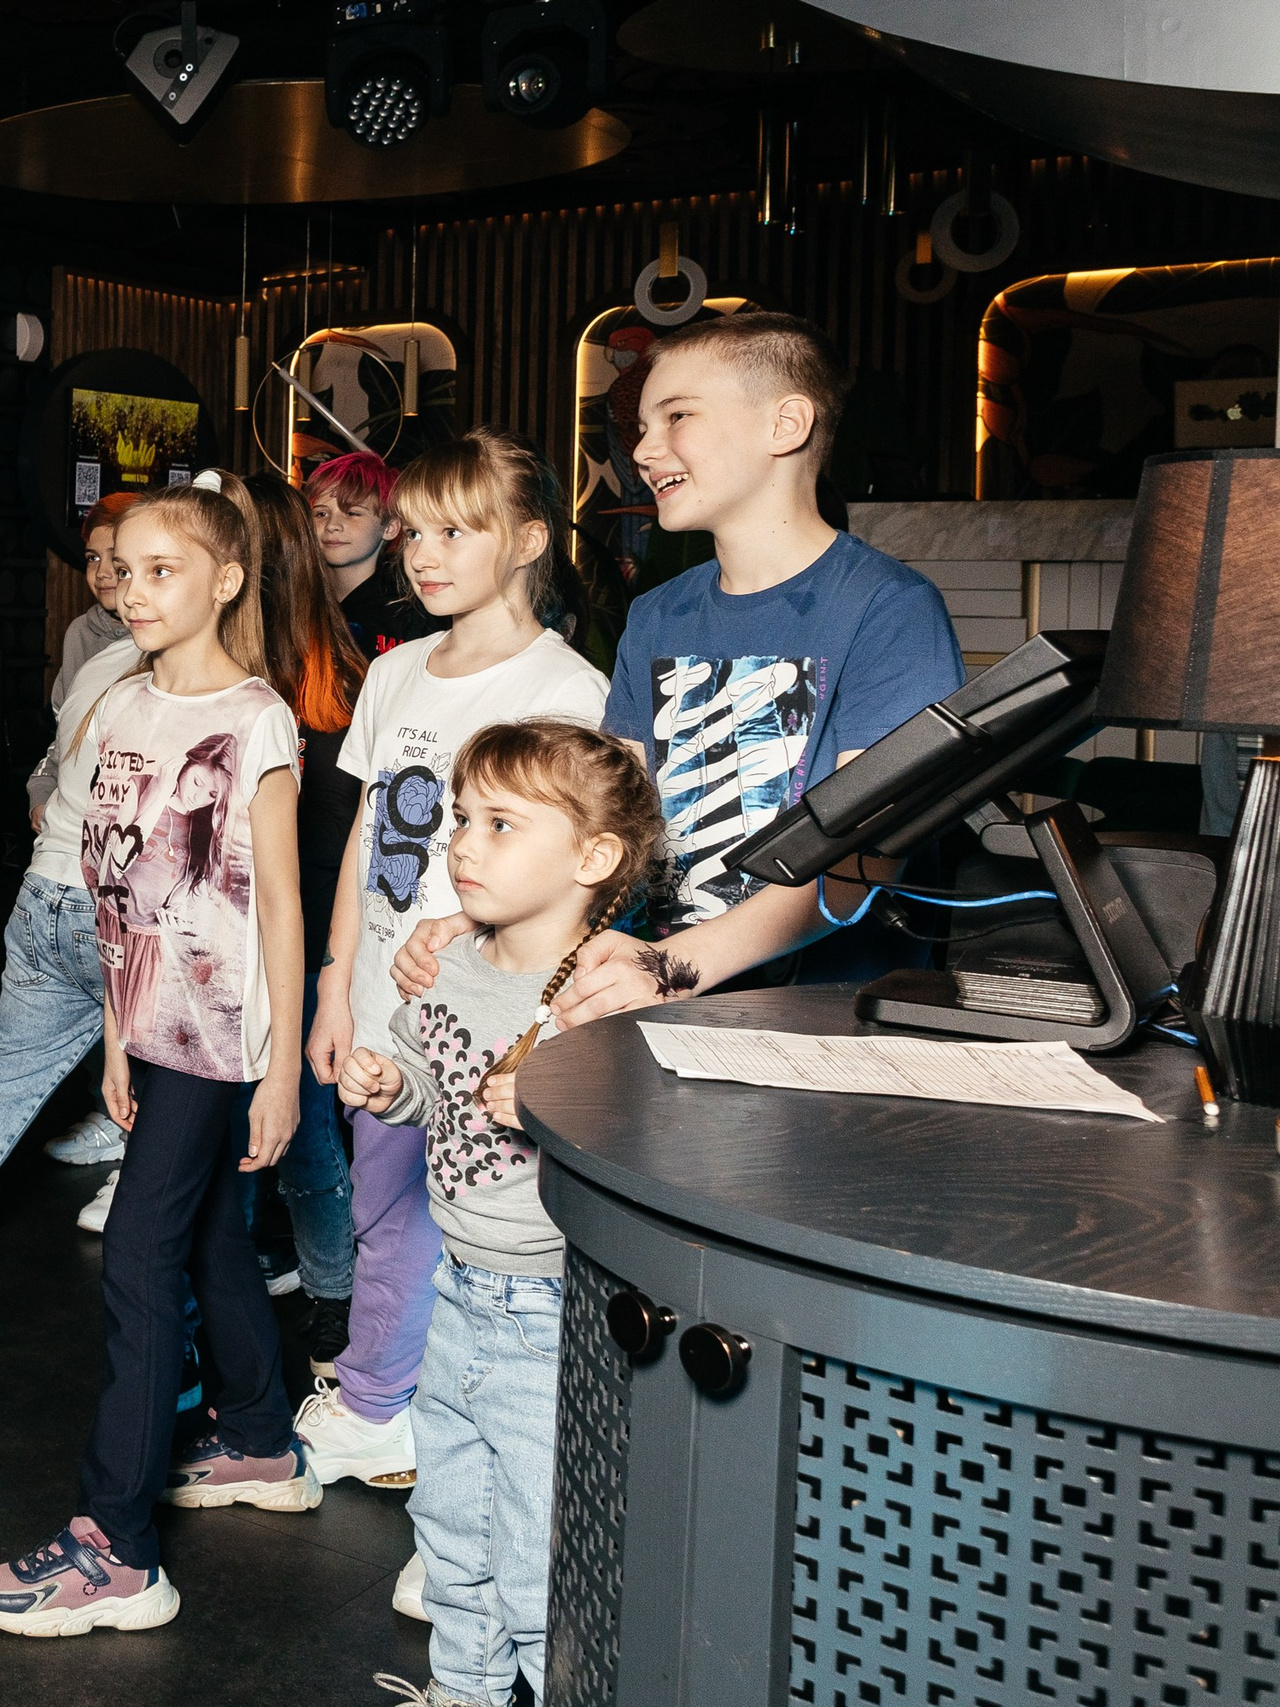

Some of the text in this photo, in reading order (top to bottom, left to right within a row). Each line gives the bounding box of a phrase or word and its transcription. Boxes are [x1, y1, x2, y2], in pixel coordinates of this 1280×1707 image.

[397, 727, 438, 743] IT'S ALL
[402, 745, 428, 759] RIDE
[109, 782, 131, 803] MY
